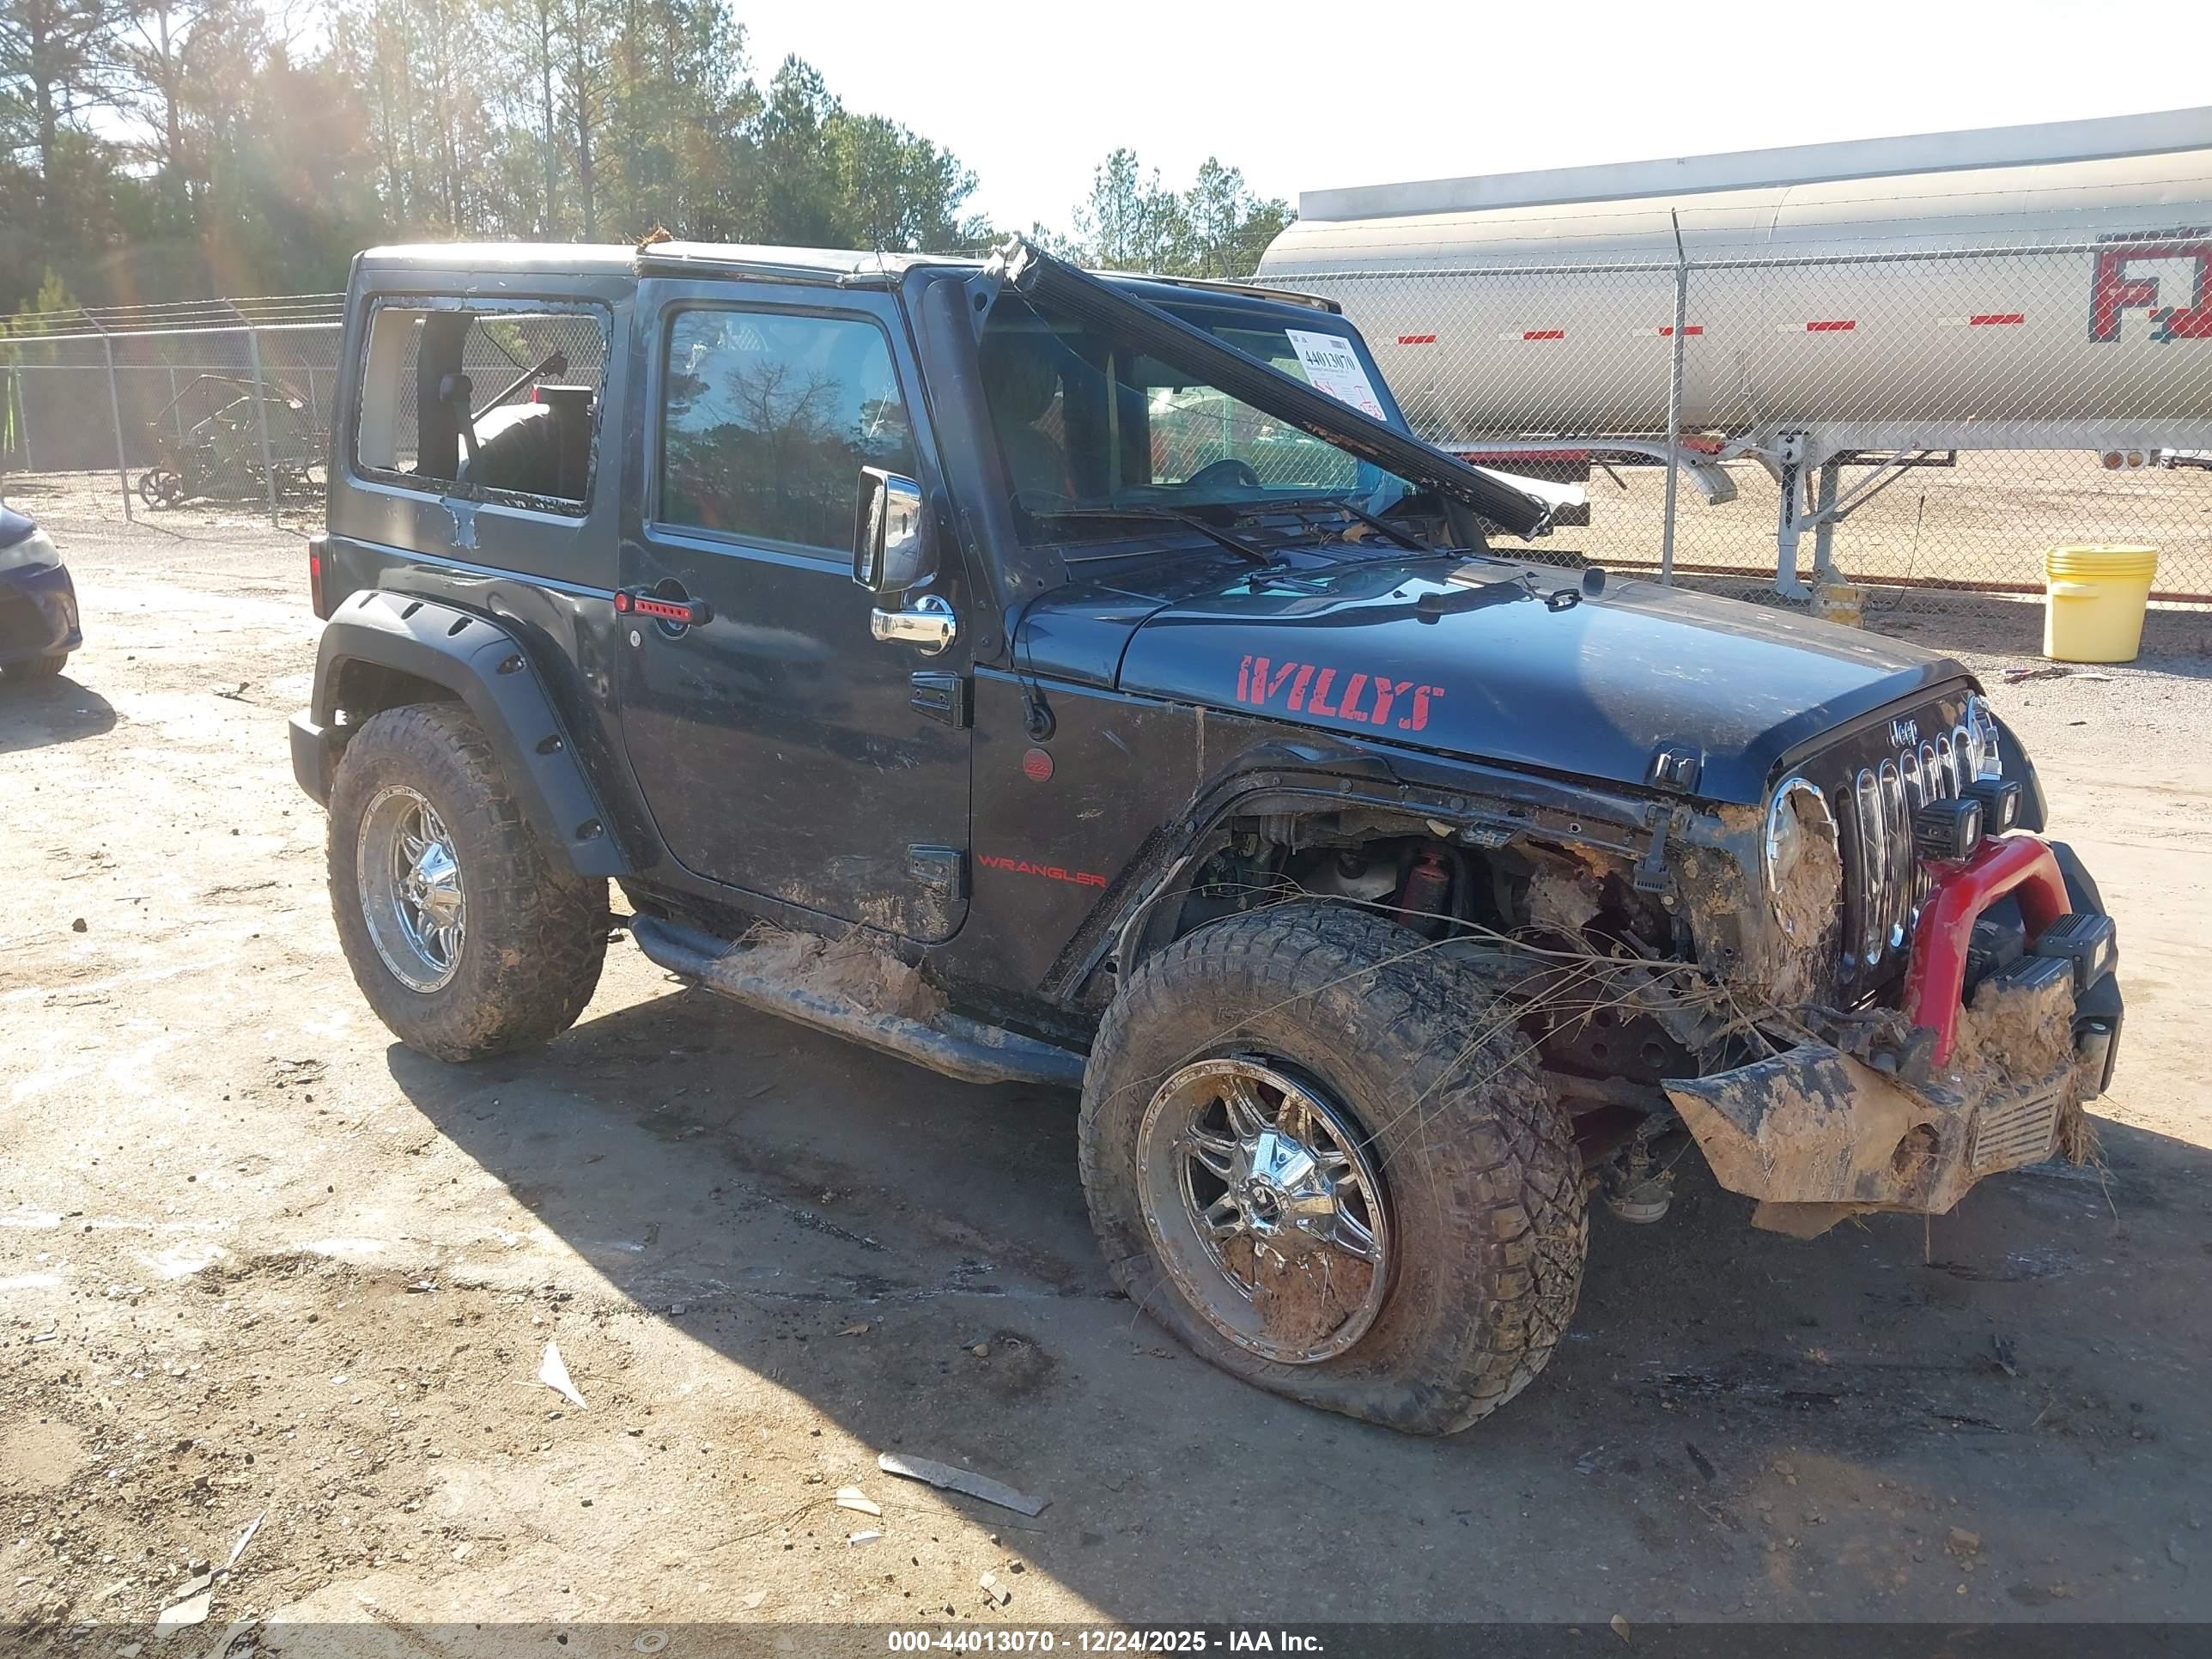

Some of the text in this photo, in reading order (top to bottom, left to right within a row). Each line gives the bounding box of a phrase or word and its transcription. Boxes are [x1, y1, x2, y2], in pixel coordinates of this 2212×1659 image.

[1305, 349, 1356, 371] 44013070
[1237, 654, 1444, 731] WILLYS
[1887, 719, 1917, 748] Jeep
[977, 854, 1106, 887] WRANGLER
